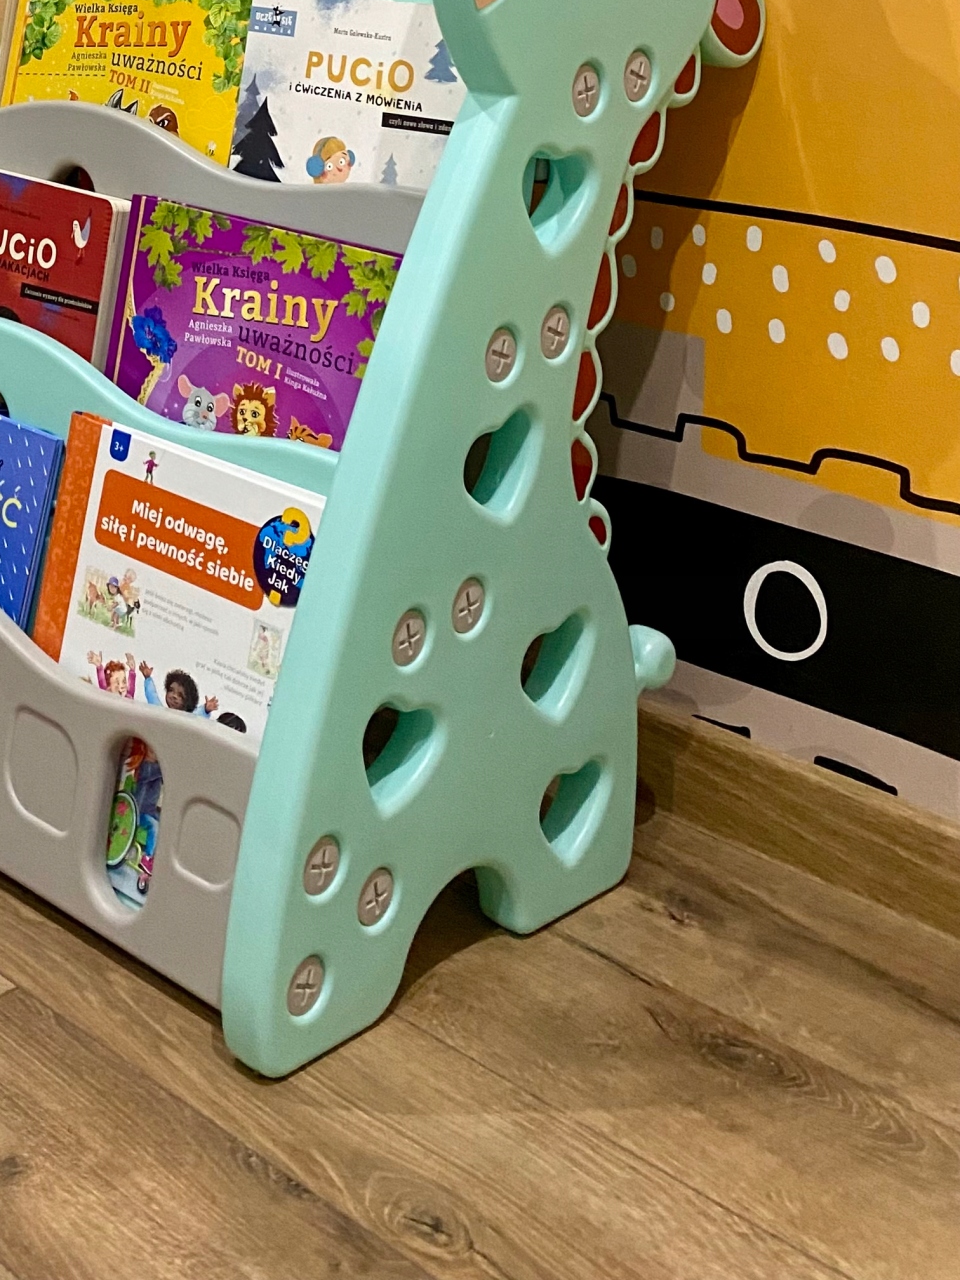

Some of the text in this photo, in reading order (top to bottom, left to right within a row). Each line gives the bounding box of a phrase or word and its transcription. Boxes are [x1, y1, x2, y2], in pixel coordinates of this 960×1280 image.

[75, 3, 138, 15] Wielka Księga
[74, 11, 192, 58] Krainy
[67, 63, 106, 72] Pawłowska
[71, 52, 107, 62] Agnieszka
[111, 52, 203, 81] uważności
[109, 69, 138, 90] TOM
[139, 78, 151, 94] II
[305, 50, 415, 93] PUCiO
[289, 82, 292, 91] i
[355, 93, 363, 103] Z
[191, 261, 270, 283] Wielka Księga
[192, 276, 339, 343] Krainy
[188, 319, 233, 333] Agnieszka
[184, 332, 232, 348] Pawłowska
[238, 325, 355, 375] uważności
[236, 346, 283, 380] TOM I
[114, 442, 124, 452] 3+
[131, 499, 229, 555] Miej odwagę,
[101, 515, 255, 592] siłę i pewność siebie
[262, 536, 309, 573] Dlaczeg
[267, 554, 301, 585] Kiedy
[268, 572, 289, 594] Jak
